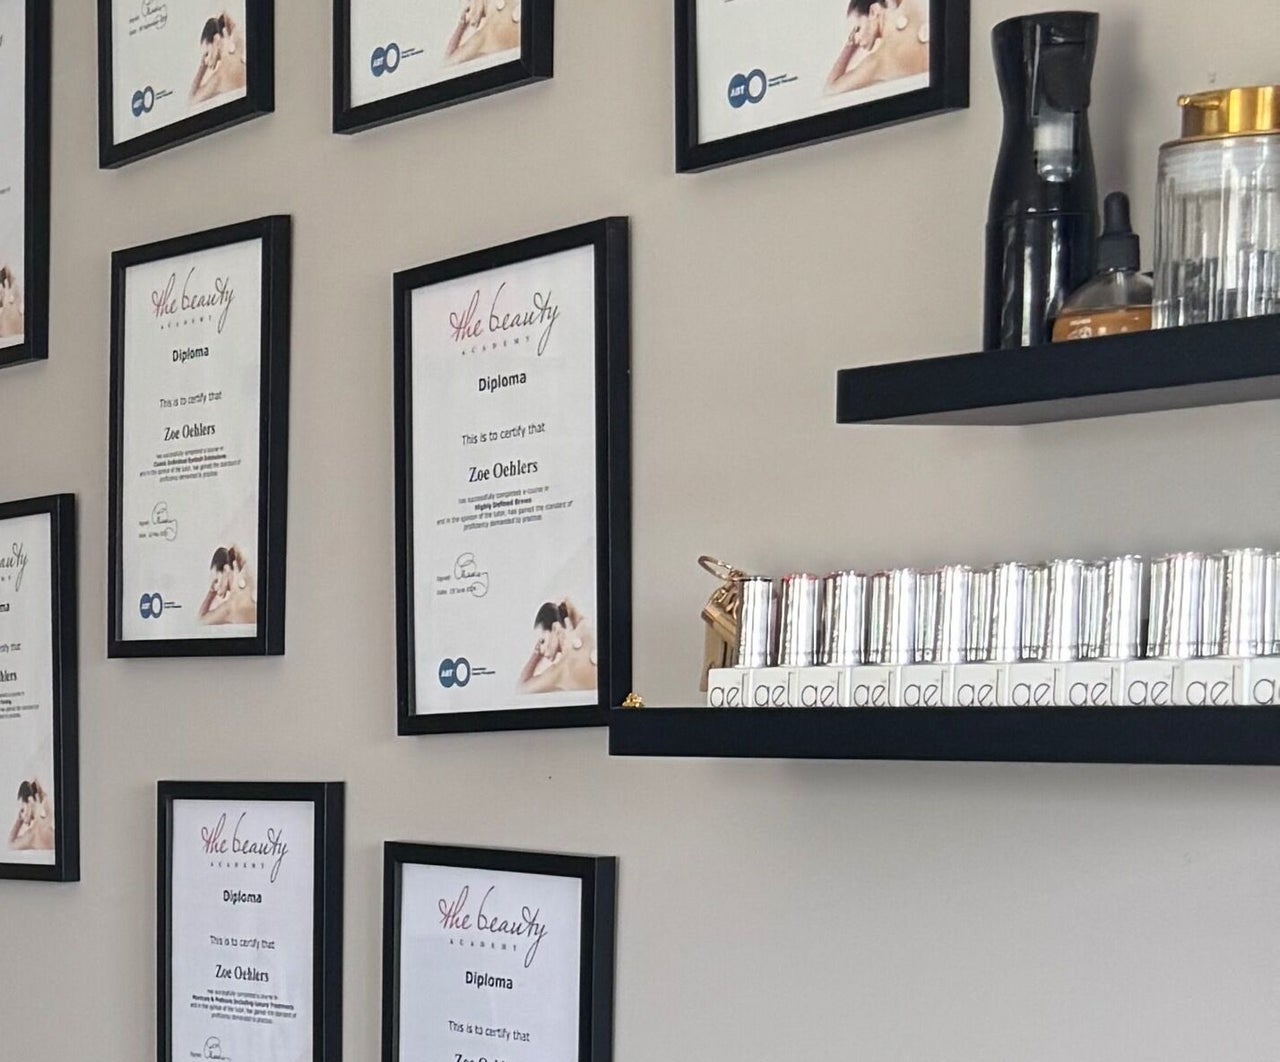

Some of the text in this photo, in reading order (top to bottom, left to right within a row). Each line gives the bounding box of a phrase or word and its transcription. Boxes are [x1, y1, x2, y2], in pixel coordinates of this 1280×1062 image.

[151, 266, 234, 334] the beauty
[450, 282, 560, 356] the beauty
[172, 346, 209, 363] Diploma
[478, 372, 527, 393] Diploma
[469, 466, 490, 482] Zoe
[201, 811, 288, 883] the beauty
[223, 889, 262, 905] Diploma
[438, 885, 548, 968] the beauty
[465, 970, 513, 989] Diploma
